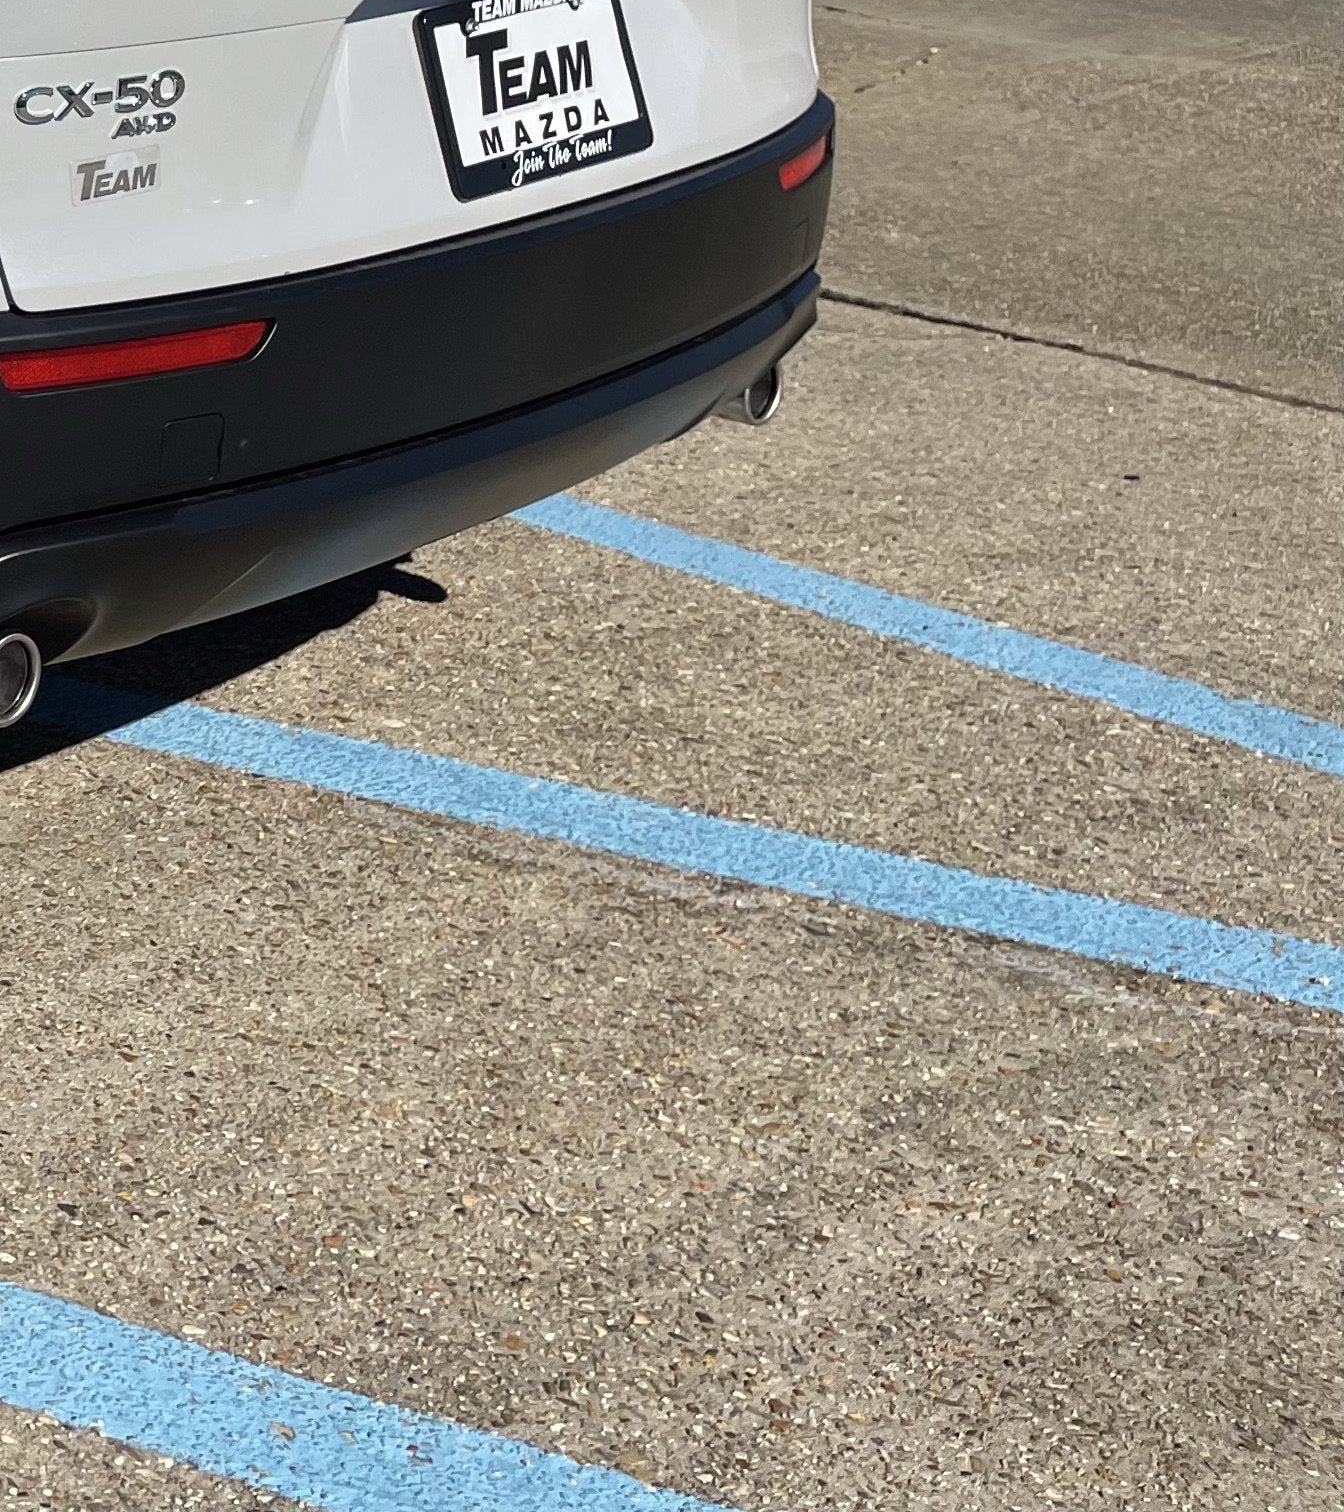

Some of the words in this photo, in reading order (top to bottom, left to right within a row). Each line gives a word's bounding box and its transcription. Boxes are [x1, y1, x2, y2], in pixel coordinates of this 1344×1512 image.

[13, 68, 186, 126] CX-50
[466, 28, 593, 116] TEAM
[110, 110, 178, 140] AWD
[478, 97, 610, 157] MAZDA
[75, 158, 158, 202] TEAM
[511, 144, 545, 187] Join
[542, 139, 572, 170] The
[569, 129, 614, 162] Team!
